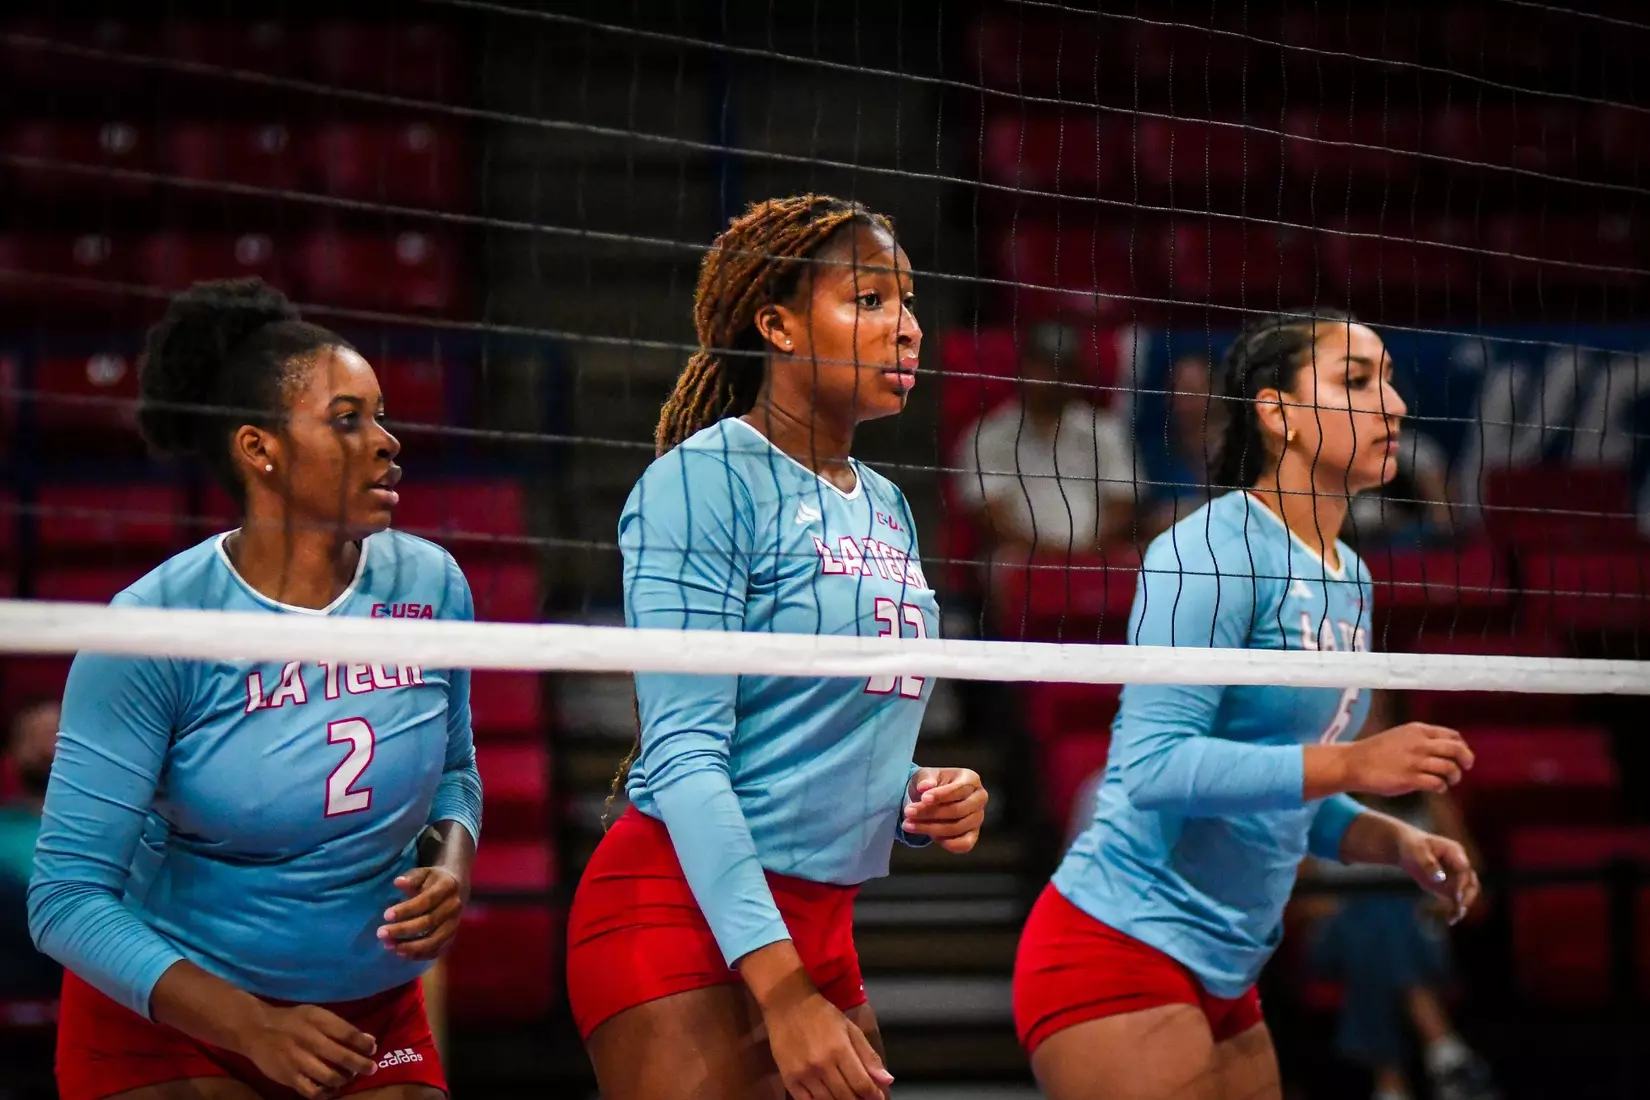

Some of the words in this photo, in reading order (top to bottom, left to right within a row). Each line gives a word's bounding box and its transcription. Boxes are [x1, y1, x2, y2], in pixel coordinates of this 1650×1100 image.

[813, 536, 872, 576] LA
[244, 660, 308, 714] LA
[324, 716, 376, 818] 2
[378, 1053, 423, 1068] adidas
